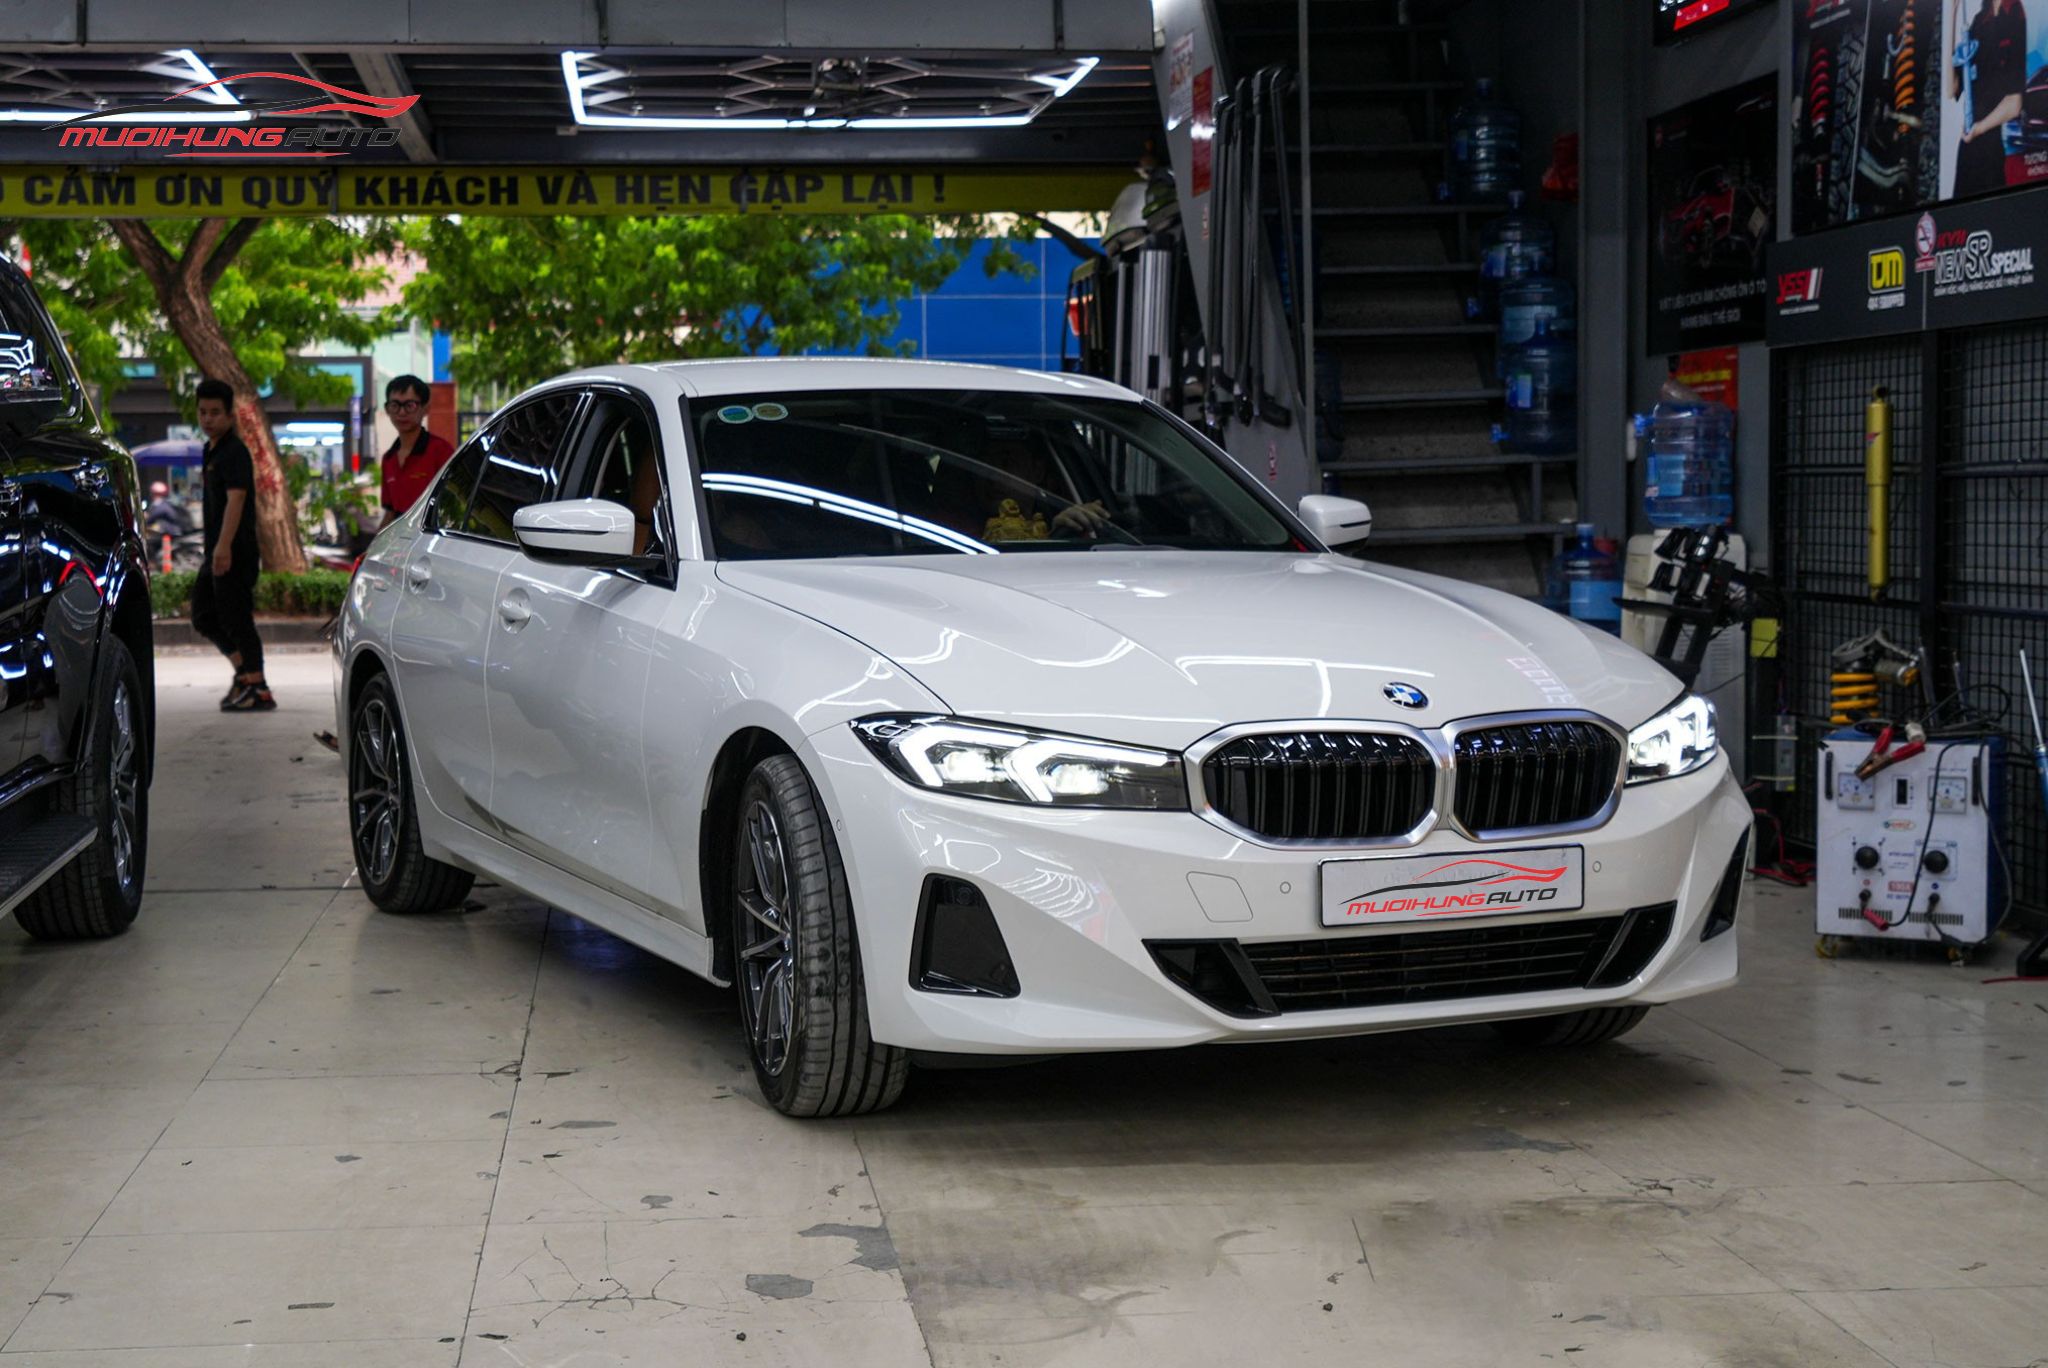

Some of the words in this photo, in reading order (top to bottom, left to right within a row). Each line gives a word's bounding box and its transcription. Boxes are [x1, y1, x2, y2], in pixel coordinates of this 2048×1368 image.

[23, 166, 136, 206] CẢM
[155, 173, 223, 206] ƠN
[241, 170, 334, 210] QUÝ
[355, 170, 520, 206] KHÁCH
[535, 169, 599, 206] VÀ
[614, 174, 712, 212] HẸN
[729, 169, 825, 212] GẶP
[841, 174, 914, 211] LẠI
[1990, 247, 2034, 277] SPECIAL
